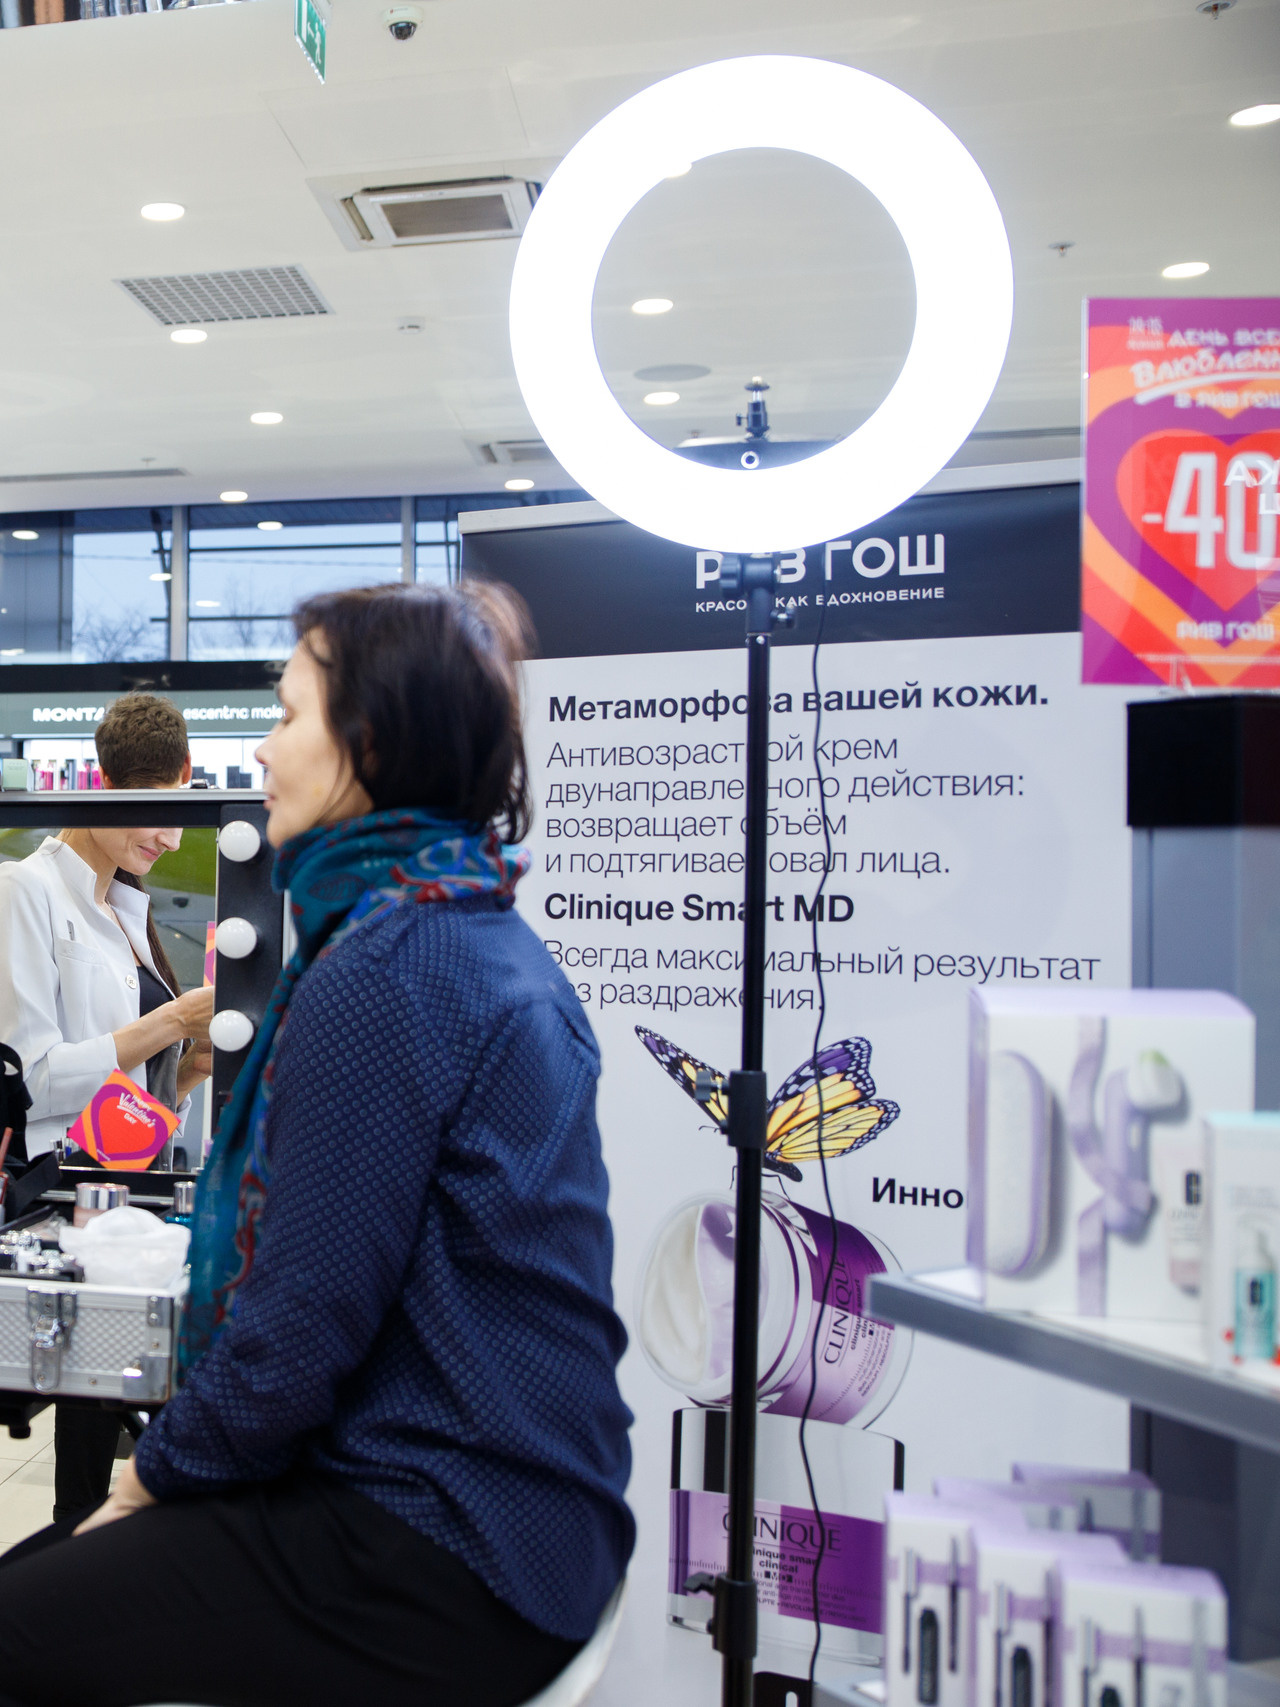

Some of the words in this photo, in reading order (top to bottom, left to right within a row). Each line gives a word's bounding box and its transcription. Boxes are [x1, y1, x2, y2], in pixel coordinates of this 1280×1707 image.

[696, 547, 807, 590] РВ
[825, 533, 945, 581] ГОШ
[696, 599, 748, 613] КРАСО
[775, 594, 808, 608] КАК
[251, 703, 287, 720] mole
[548, 689, 793, 723] Метаморфоа
[802, 681, 922, 712] вашей
[932, 684, 1048, 708] кожи.
[546, 733, 803, 771] Антивозрастой
[815, 738, 898, 767] крем
[545, 776, 840, 808] двунаправленого
[848, 768, 1024, 803] действия:
[546, 815, 733, 843] возвращает
[545, 853, 562, 873] и
[570, 851, 745, 879] подтягивае
[768, 851, 847, 873] овал
[855, 851, 949, 879] лица.
[544, 893, 674, 926] Clinique
[793, 894, 854, 923] MD
[543, 940, 648, 974] Всегда
[913, 953, 1102, 984] результат
[872, 1176, 966, 1209] Инно
[722, 1512, 842, 1552] INIQUE
[759, 1558, 799, 1574] clinical
[789, 1554, 818, 1567] smar
